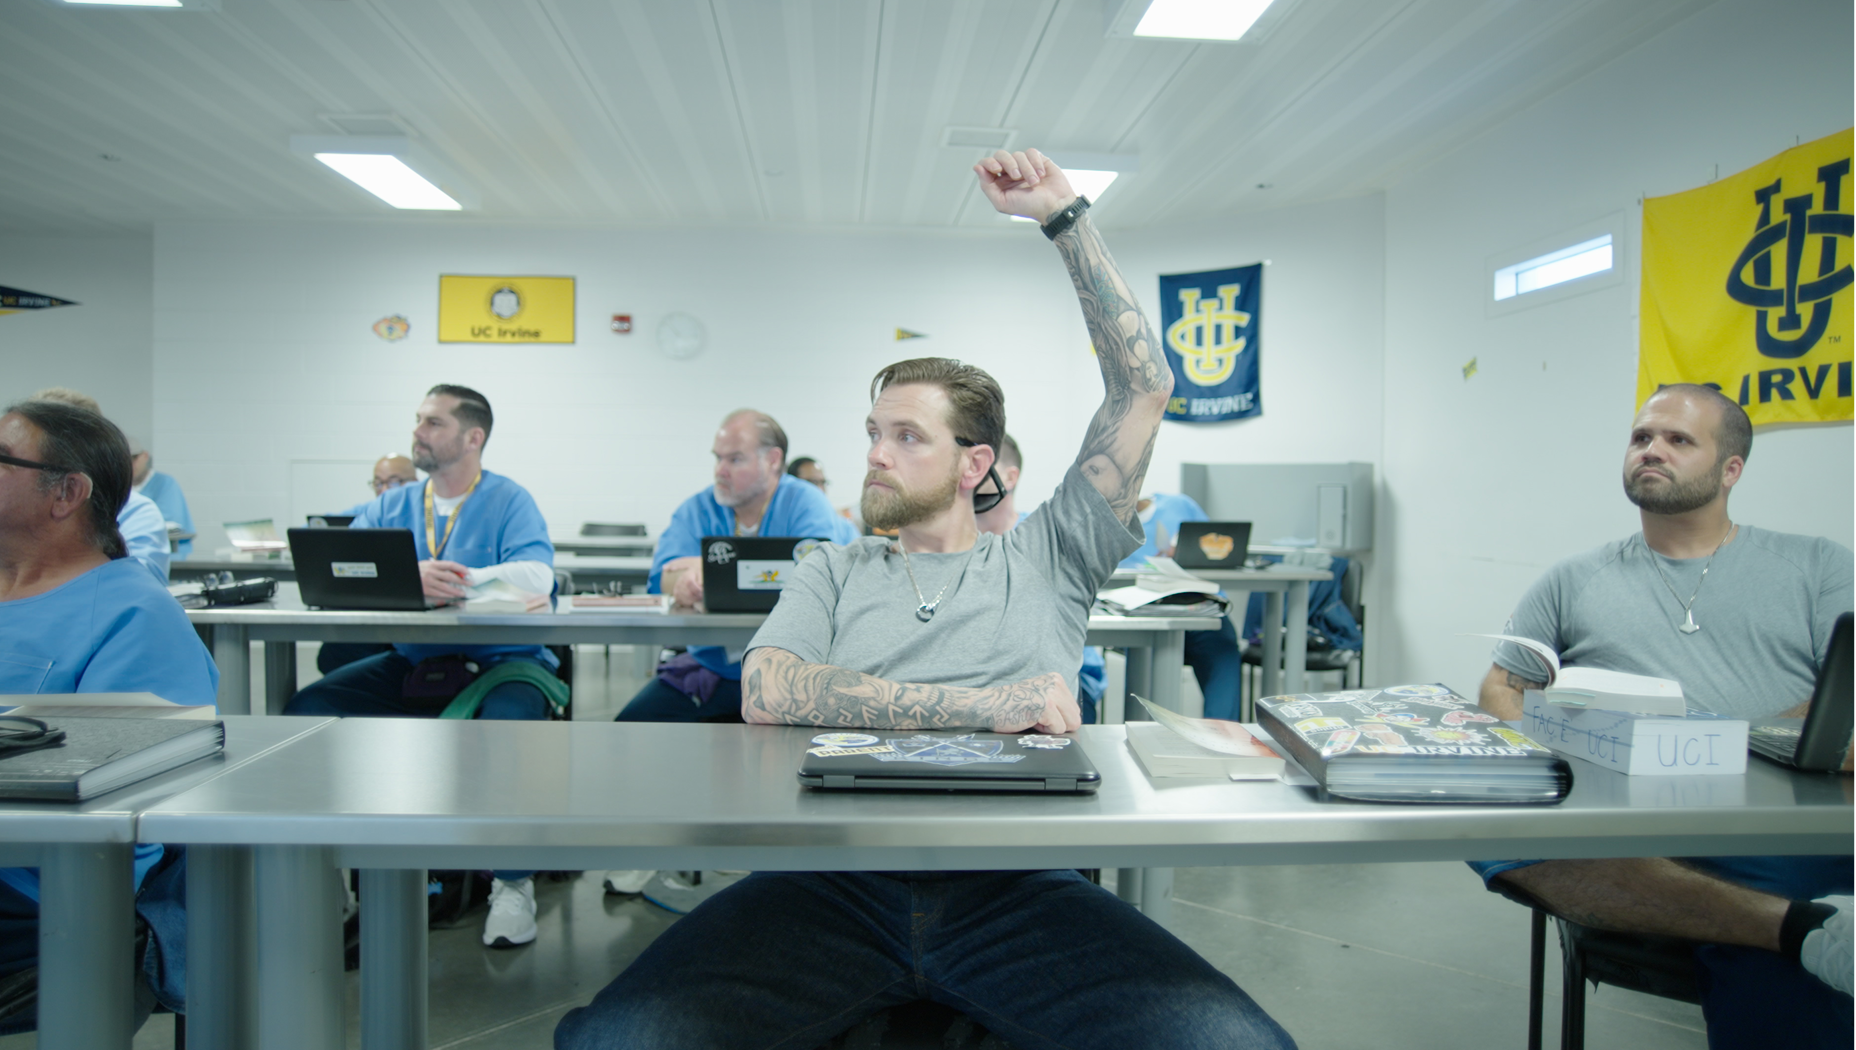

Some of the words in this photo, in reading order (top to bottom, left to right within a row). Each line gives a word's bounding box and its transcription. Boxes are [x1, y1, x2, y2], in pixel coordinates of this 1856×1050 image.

[471, 326, 492, 338] UC
[497, 325, 541, 338] Irvine
[1828, 336, 1841, 344] TM
[1190, 393, 1253, 415] IRVINE
[1354, 745, 1402, 754] UC
[1411, 746, 1526, 756] IRVINE
[1587, 729, 1619, 763] UCI
[1657, 733, 1721, 767] UCI
